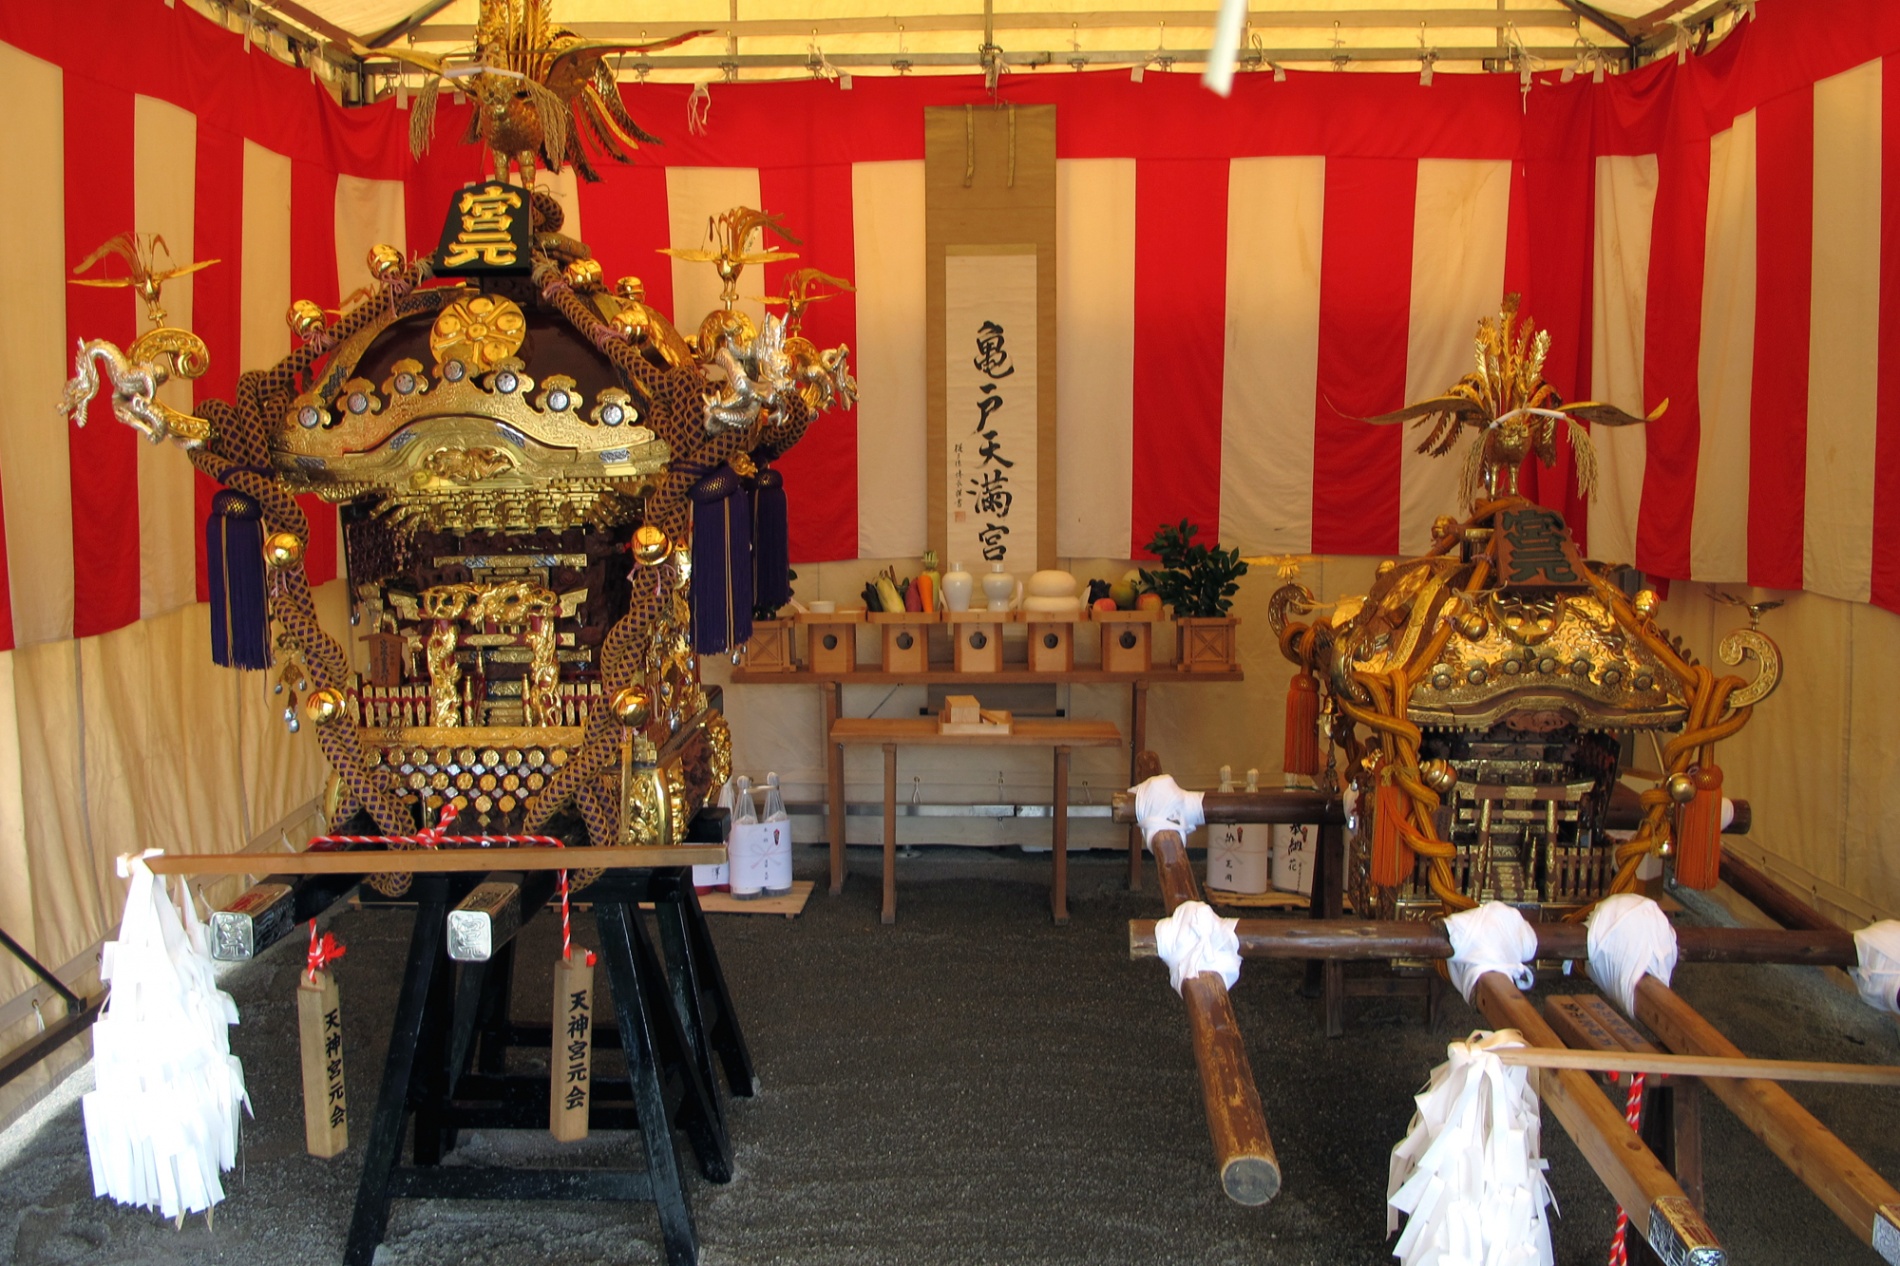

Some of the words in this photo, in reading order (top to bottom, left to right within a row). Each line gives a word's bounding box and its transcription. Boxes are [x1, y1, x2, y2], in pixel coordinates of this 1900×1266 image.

[444, 186, 522, 267] 宮元
[966, 320, 1014, 561] 亀戸天満宮
[1502, 510, 1578, 582] 宮元
[324, 1008, 346, 1129] 天神宮元会
[565, 989, 590, 1110] 天神宮元会
